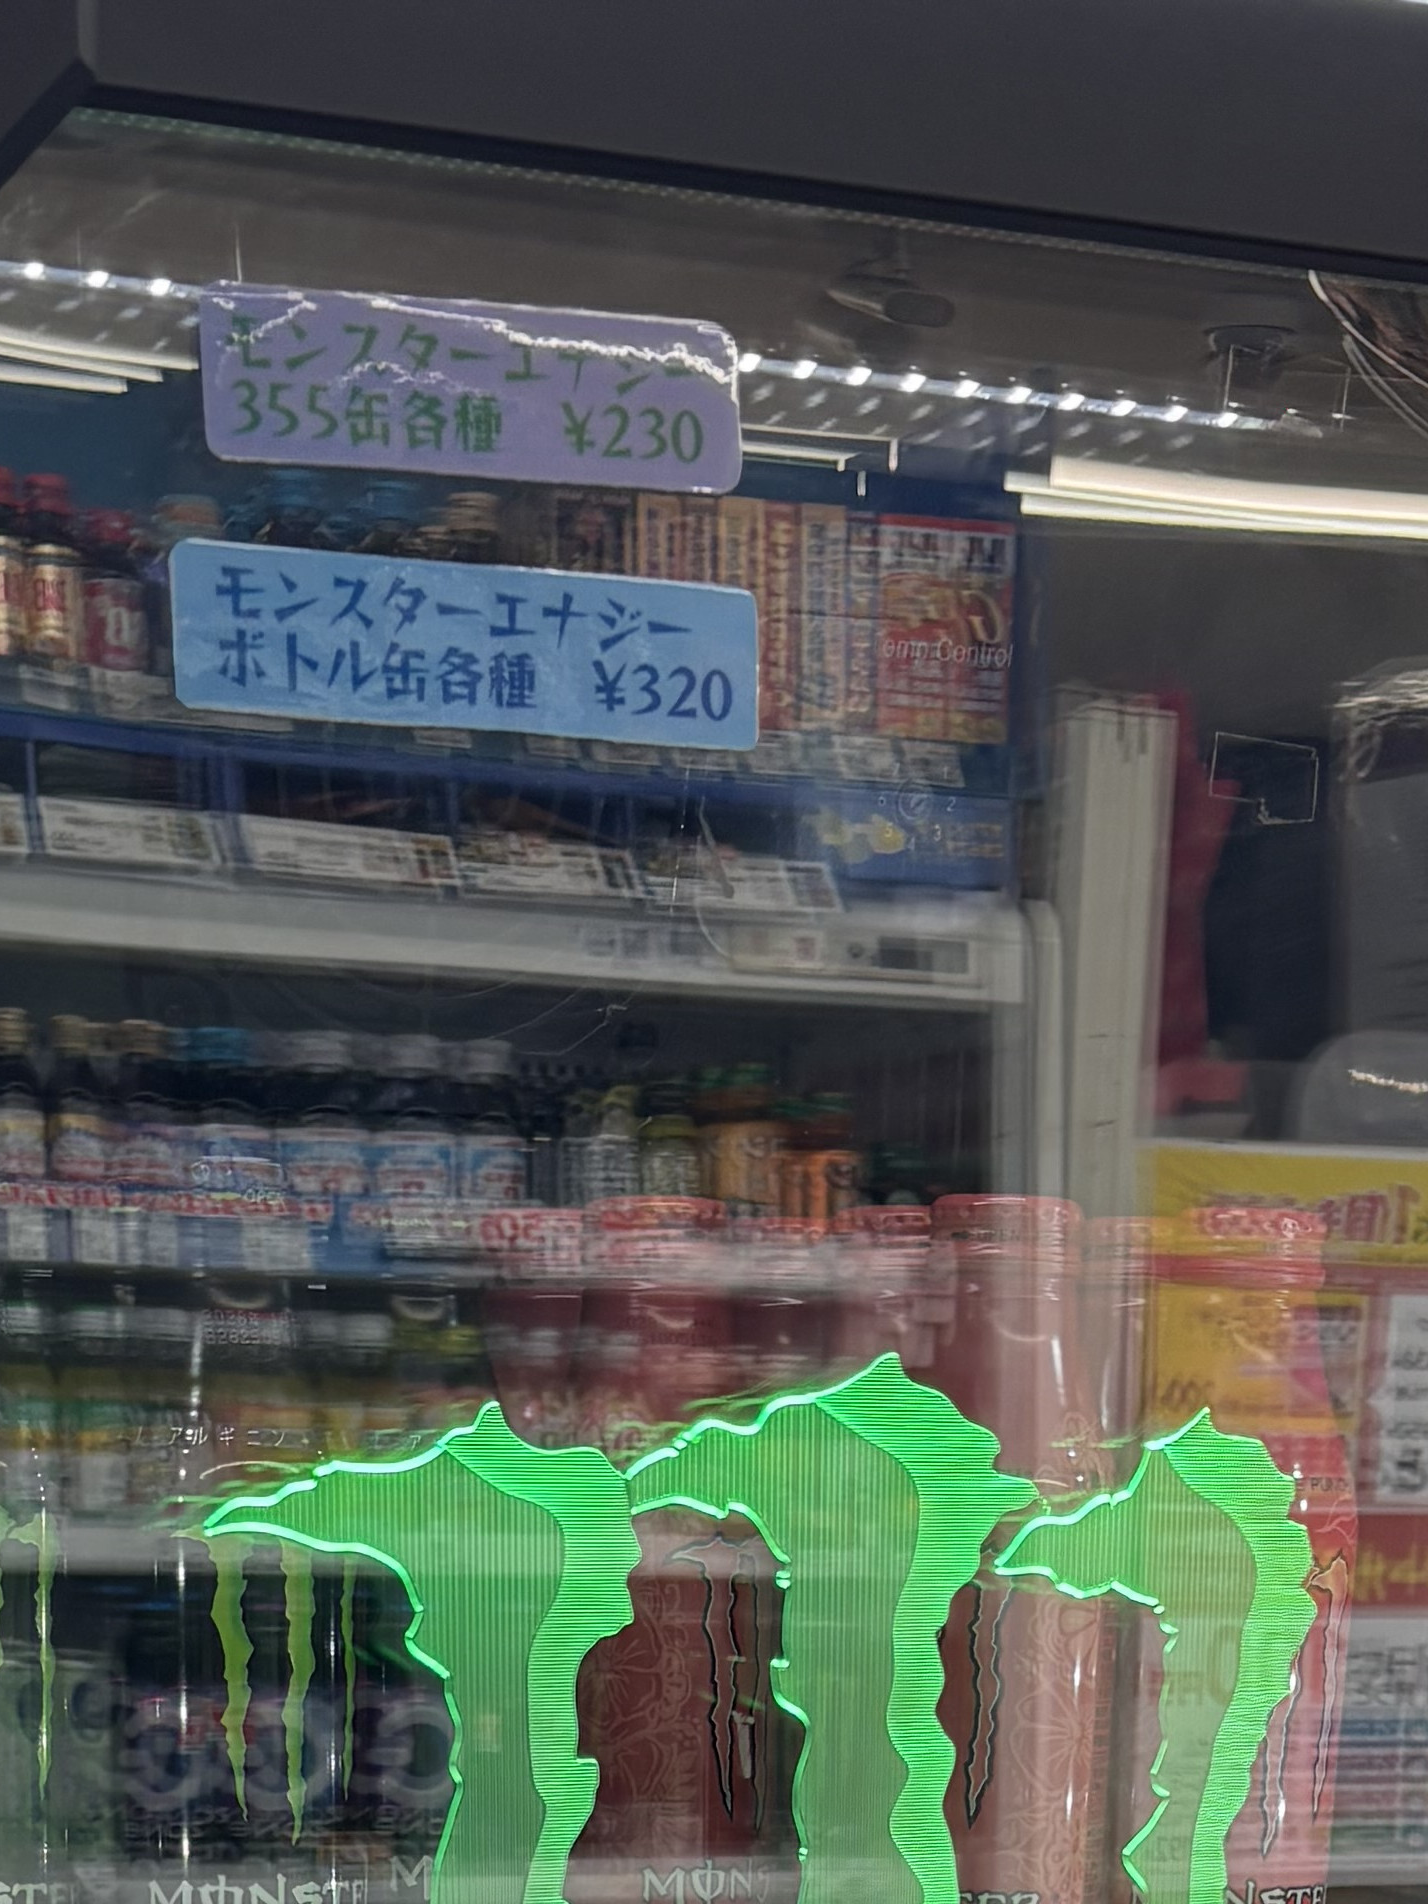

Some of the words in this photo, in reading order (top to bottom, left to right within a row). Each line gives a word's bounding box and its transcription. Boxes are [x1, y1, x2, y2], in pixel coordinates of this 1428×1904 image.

[230, 379, 503, 455] 355缶各種
[563, 404, 705, 464] ¥230
[216, 565, 693, 654] モンスターエナジー
[216, 630, 538, 713] ボトル缶各種
[592, 658, 734, 722] ¥320
